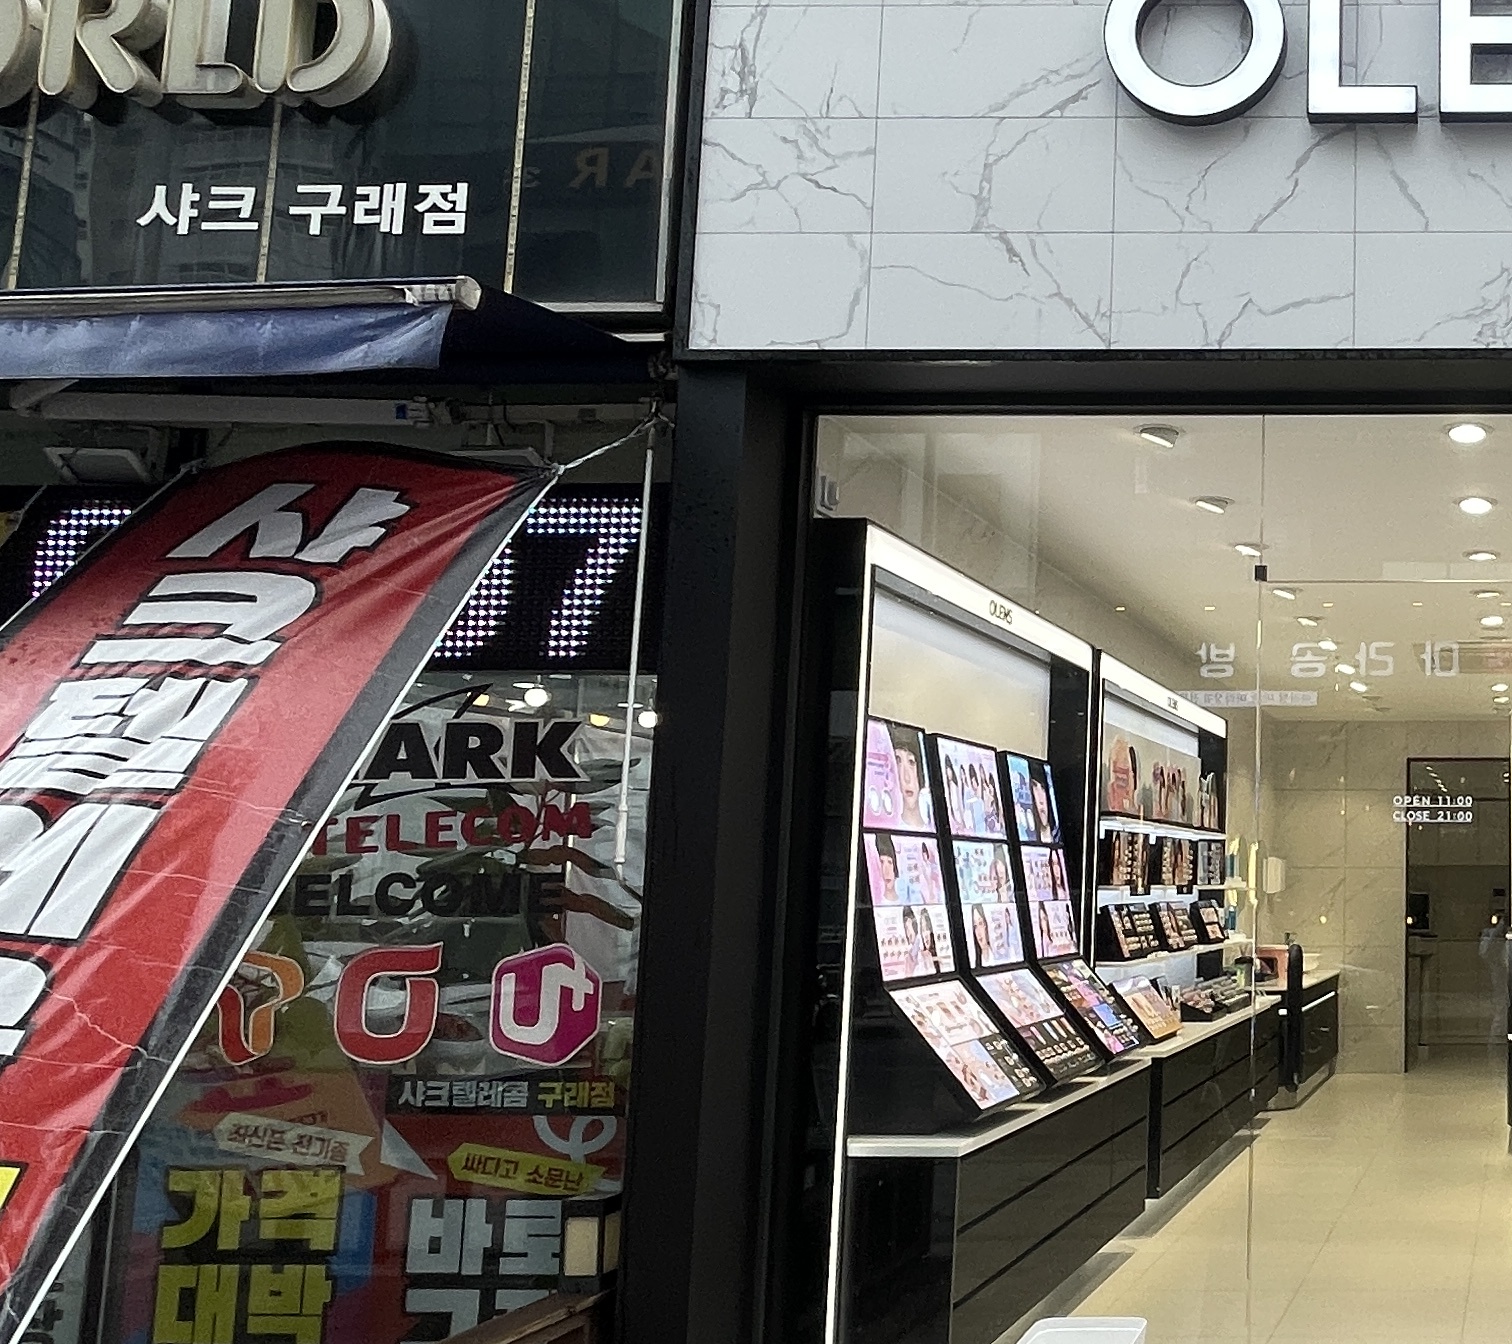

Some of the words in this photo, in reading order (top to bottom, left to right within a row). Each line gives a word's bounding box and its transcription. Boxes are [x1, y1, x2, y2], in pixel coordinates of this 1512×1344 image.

[136, 182, 260, 235] 샤크
[287, 181, 470, 236] 구래점
[352, 721, 590, 781] ARK
[1392, 795, 1431, 806] OPEN
[1392, 810, 1431, 821] CLOSE
[294, 871, 565, 918] ELCOME
[397, 1080, 529, 1108] 샤크텔레콤
[536, 1080, 616, 1109] 구래점
[160, 1169, 342, 1251] 가격
